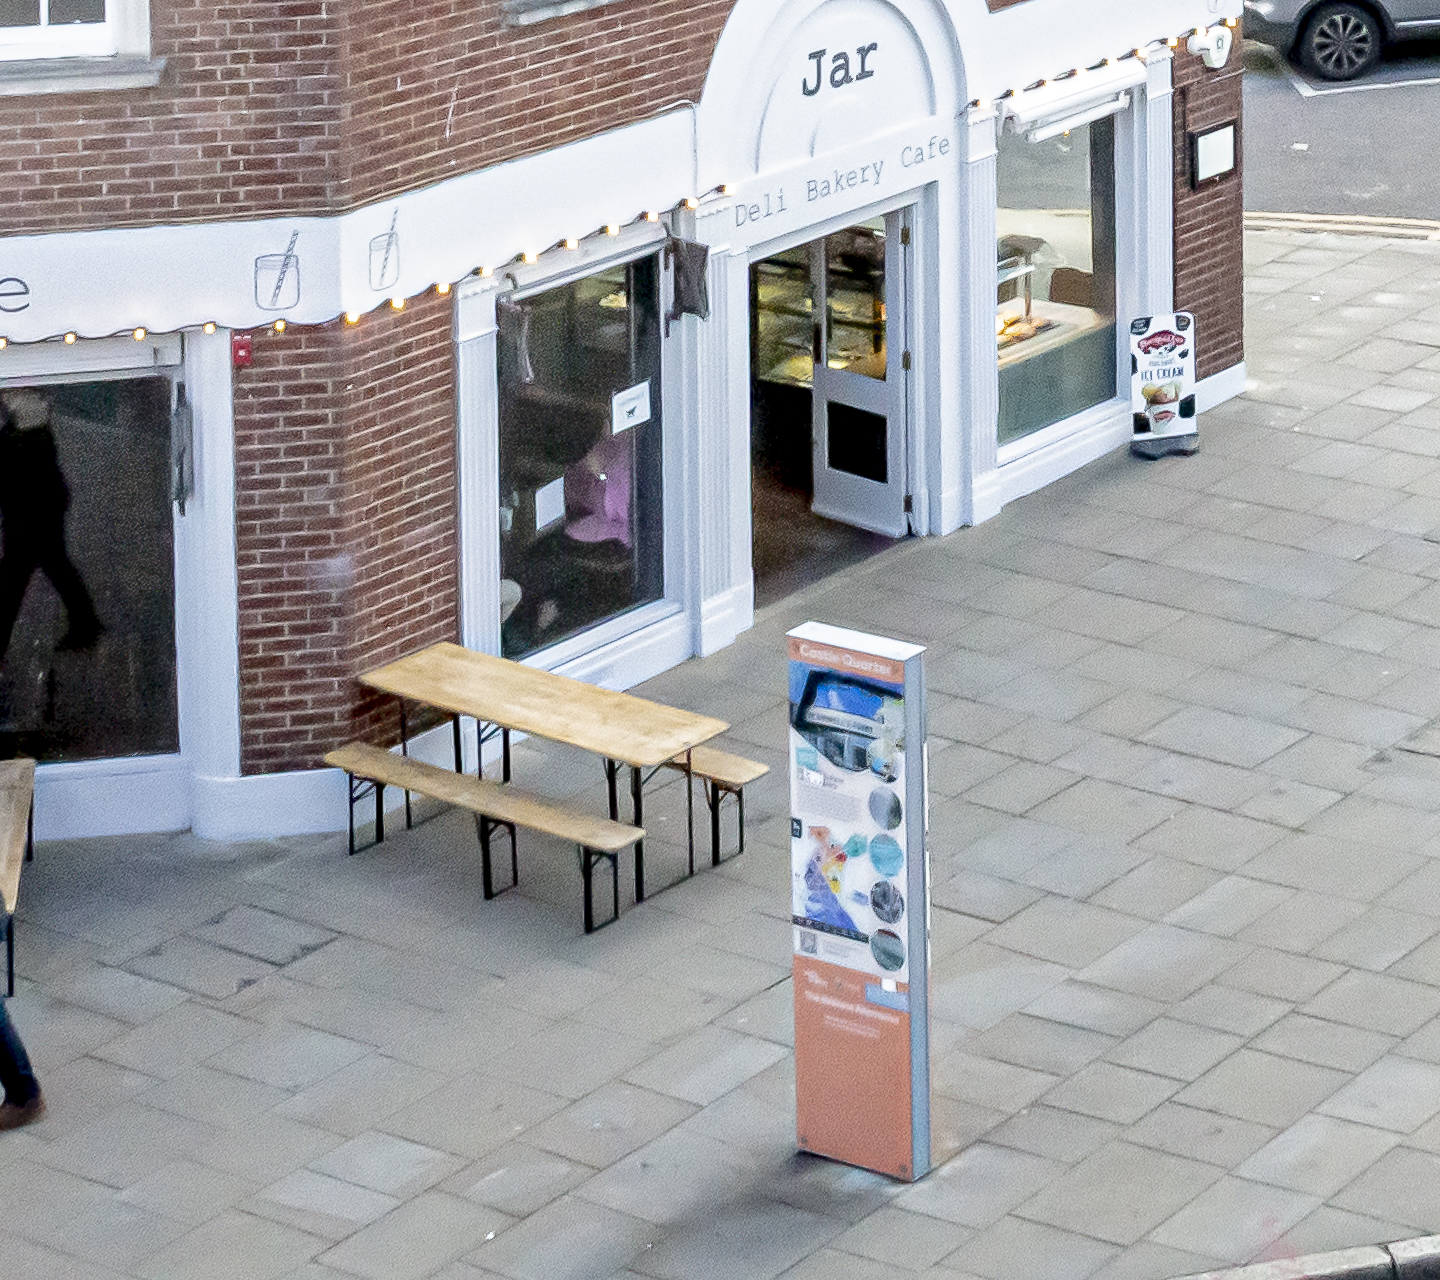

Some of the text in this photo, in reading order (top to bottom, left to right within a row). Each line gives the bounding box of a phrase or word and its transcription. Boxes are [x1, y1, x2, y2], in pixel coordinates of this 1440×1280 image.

[801, 40, 878, 98] Jar
[735, 135, 951, 228] Deli Bakery Cafe
